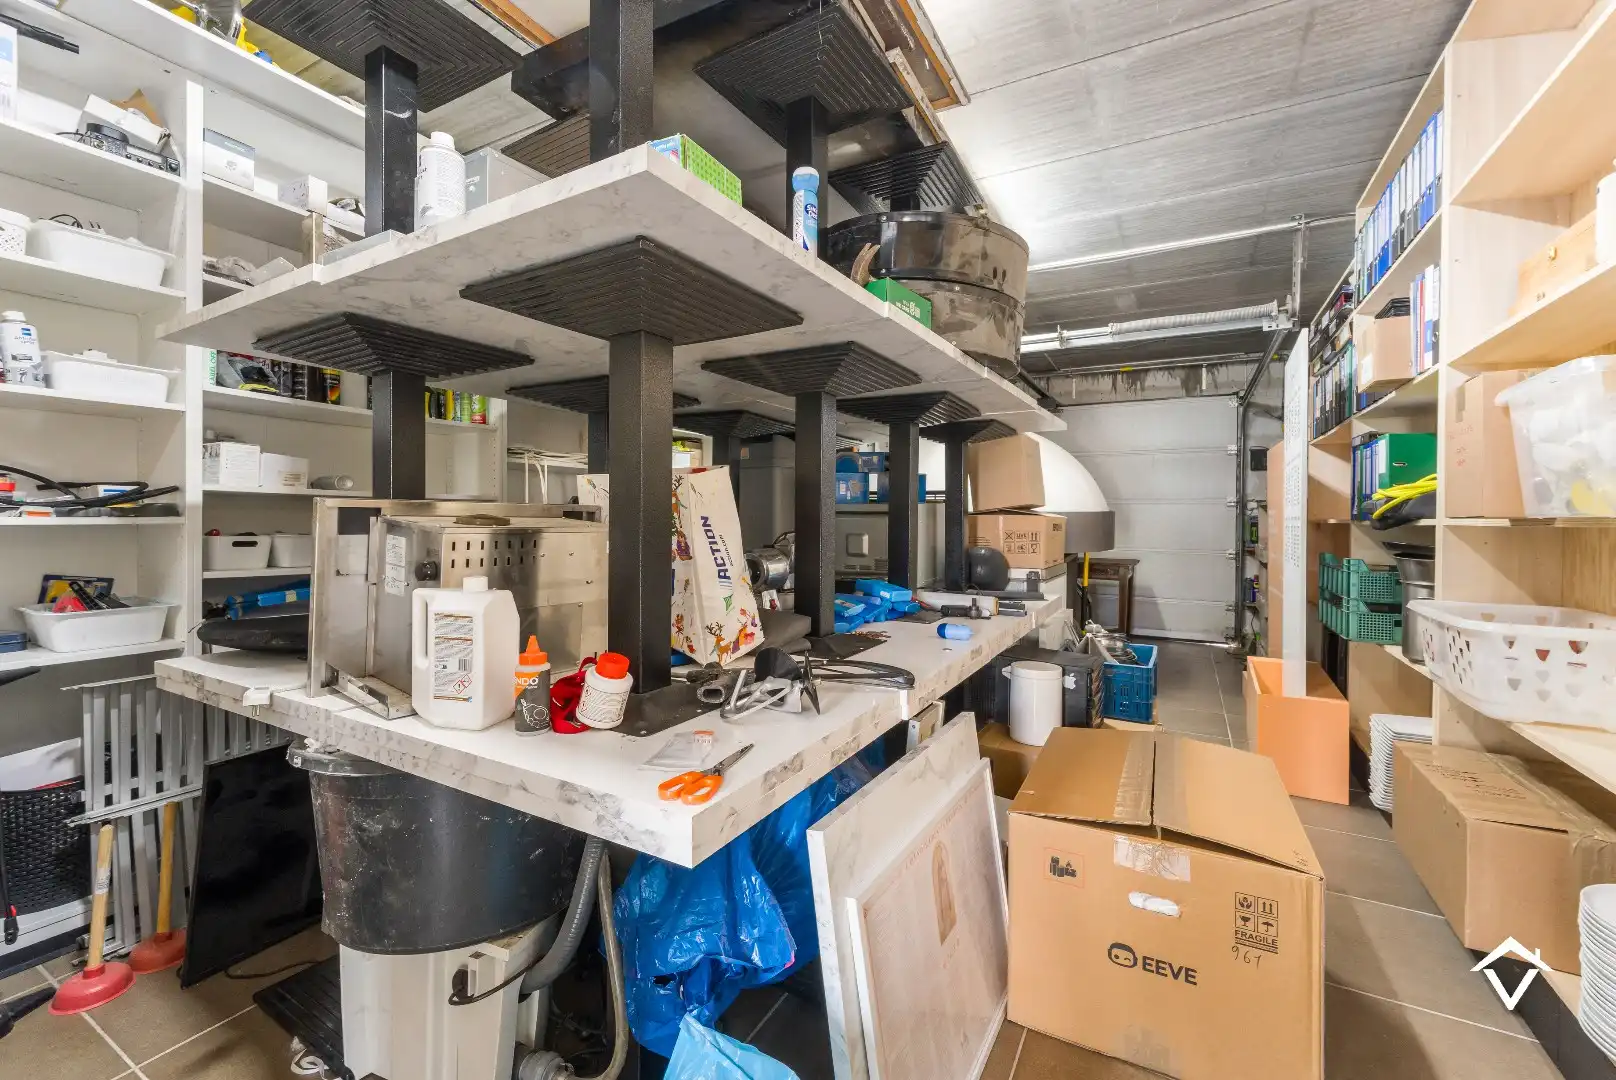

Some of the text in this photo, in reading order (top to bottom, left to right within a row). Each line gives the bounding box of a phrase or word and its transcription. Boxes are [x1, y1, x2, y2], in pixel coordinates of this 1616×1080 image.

[700, 515, 732, 580] ACTION
[1234, 929, 1279, 947] FRAGILE
[1142, 955, 1198, 986] EEVE
